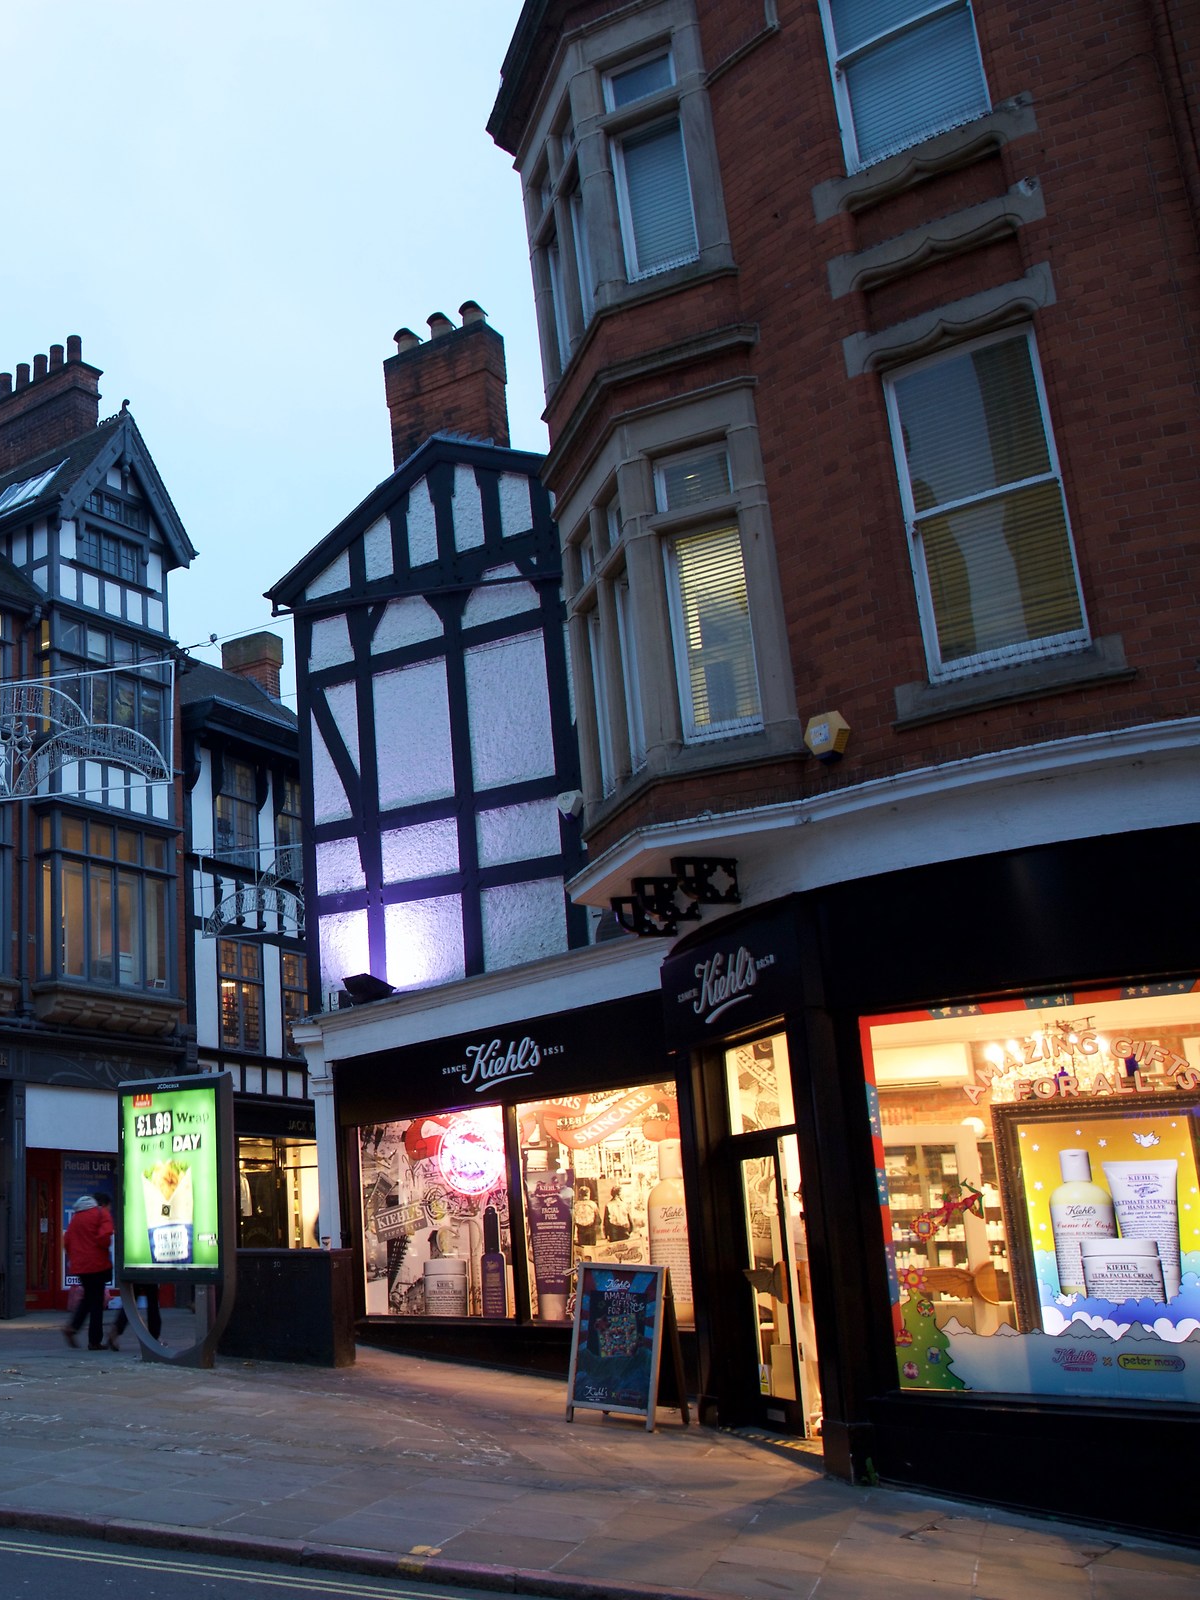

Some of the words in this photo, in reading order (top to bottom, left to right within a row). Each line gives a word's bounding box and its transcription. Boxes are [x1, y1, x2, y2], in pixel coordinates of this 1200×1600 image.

[693, 946, 757, 1014] Kiehl's
[442, 1064, 467, 1075] SINCE
[461, 1036, 541, 1084] Kiehl's
[543, 1045, 564, 1056] 1851
[962, 1032, 1099, 1105] AMAZING
[1109, 1036, 1200, 1090] GIFTS
[1014, 1075, 1081, 1101] FOR
[1091, 1070, 1154, 1096] ALL
[136, 1111, 172, 1137] £1.99
[573, 1091, 652, 1144] SKINCARE
[172, 1134, 201, 1153] DAY
[64, 1160, 90, 1171] Retail
[92, 1161, 111, 1172] Unit
[376, 1205, 423, 1229] KIEHL'S
[1065, 1205, 1096, 1216] Kiehl's
[604, 1291, 637, 1302] AMAZING
[607, 1306, 621, 1315] FOR
[1052, 1347, 1098, 1364] Kiehl's
[1122, 1357, 1152, 1367] peter
